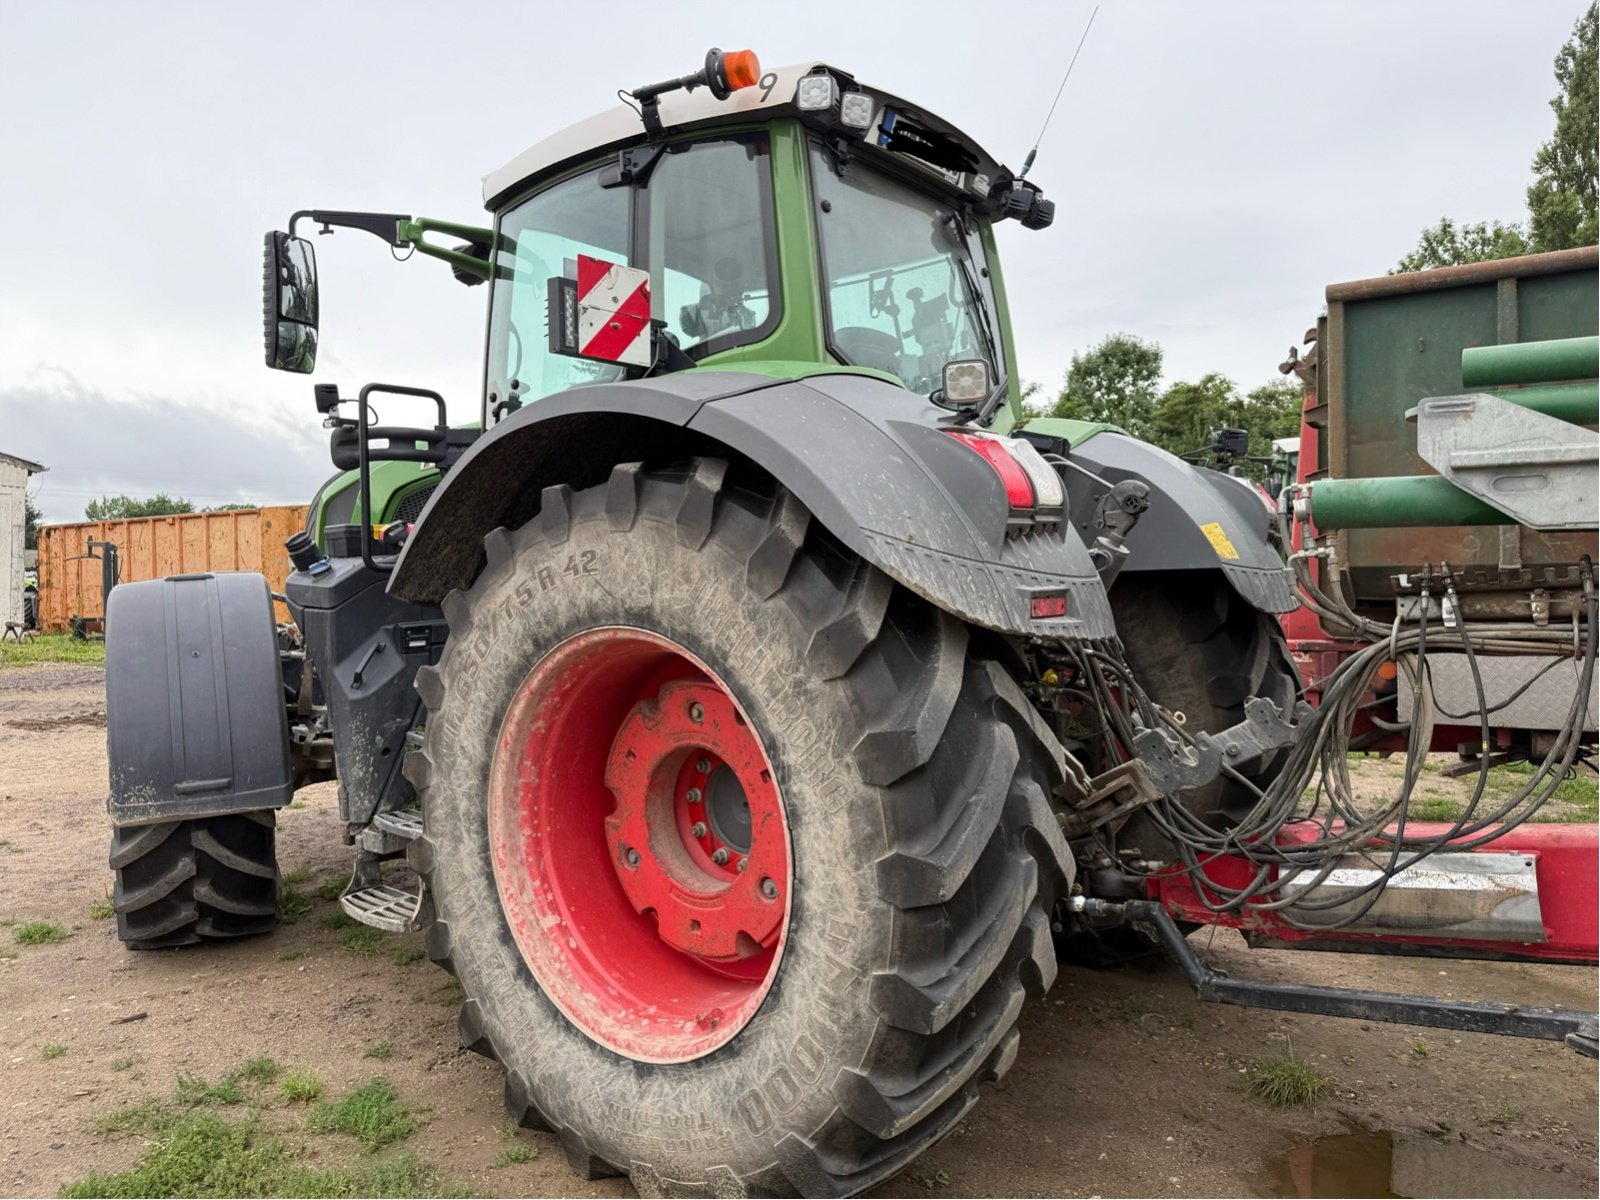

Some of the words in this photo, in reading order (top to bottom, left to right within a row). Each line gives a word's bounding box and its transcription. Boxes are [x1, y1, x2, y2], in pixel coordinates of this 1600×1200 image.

[759, 73, 778, 102] 9
[534, 565, 556, 592] R
[563, 549, 600, 578] 42
